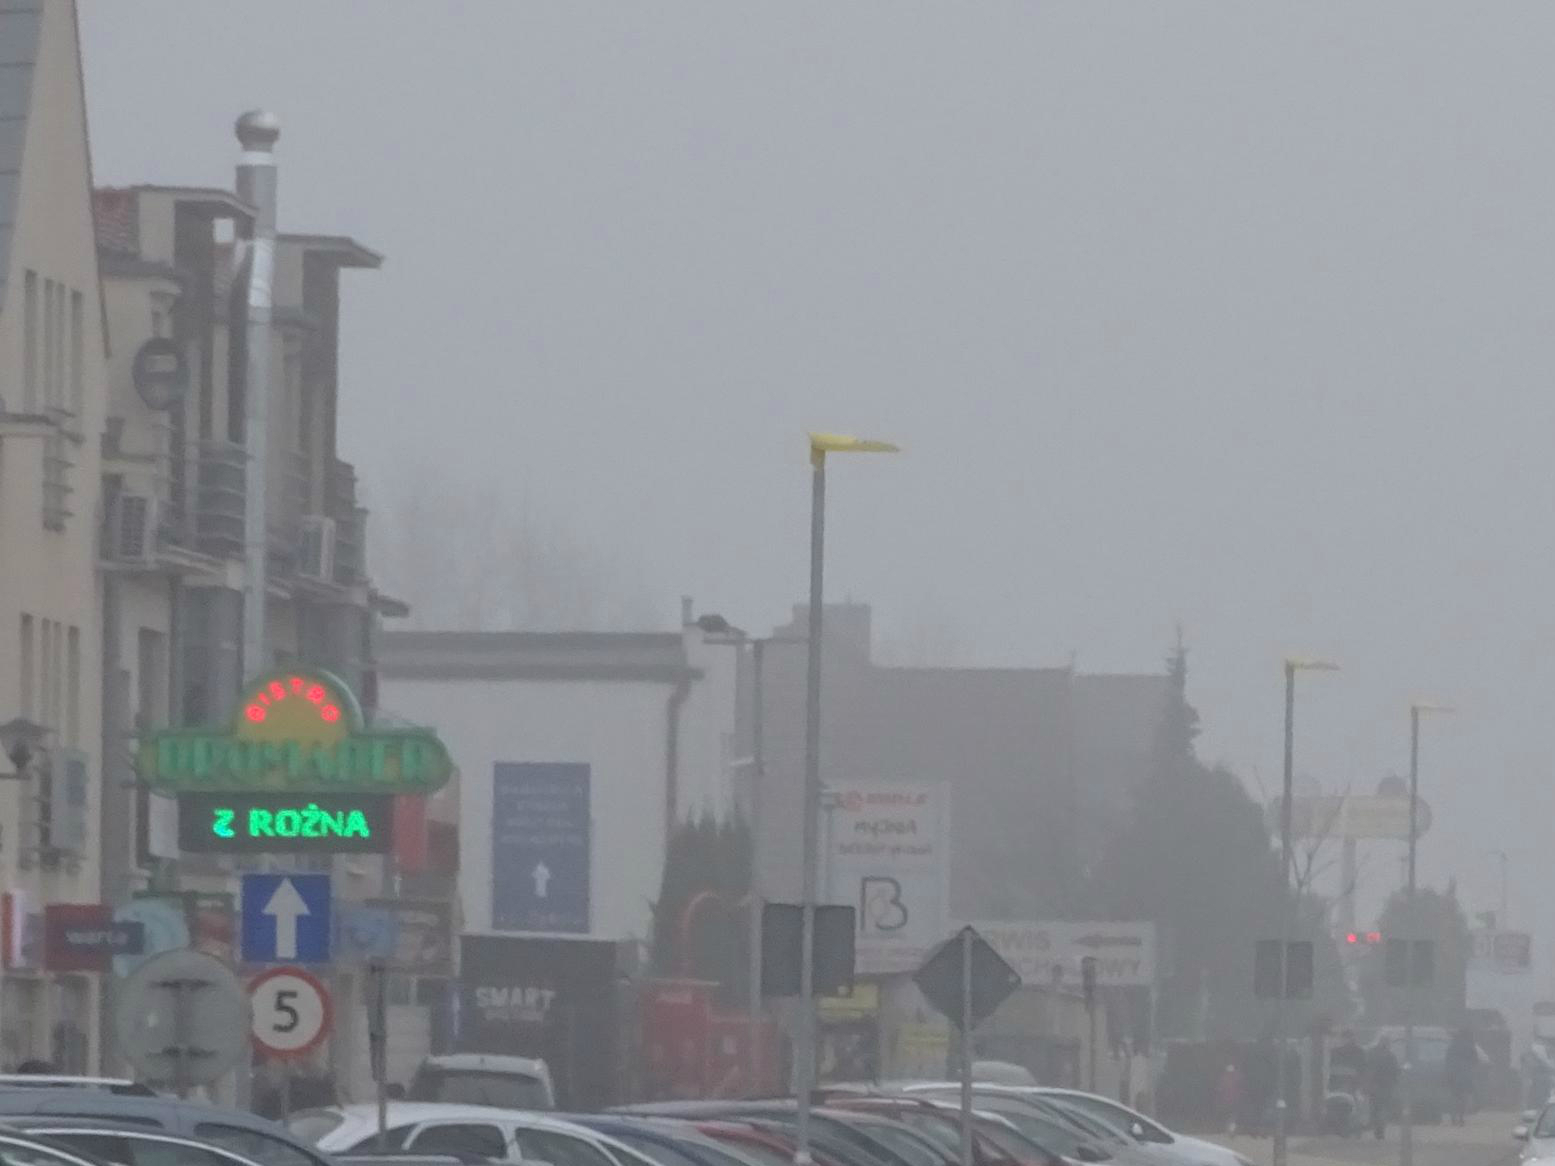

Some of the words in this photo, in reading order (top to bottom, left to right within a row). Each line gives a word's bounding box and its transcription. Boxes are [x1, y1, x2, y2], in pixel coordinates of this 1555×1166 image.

[244, 676, 341, 724] BISTRO
[248, 803, 370, 838] ROŻNA
[272, 990, 299, 1033] 5
[475, 986, 557, 1008] SMART
